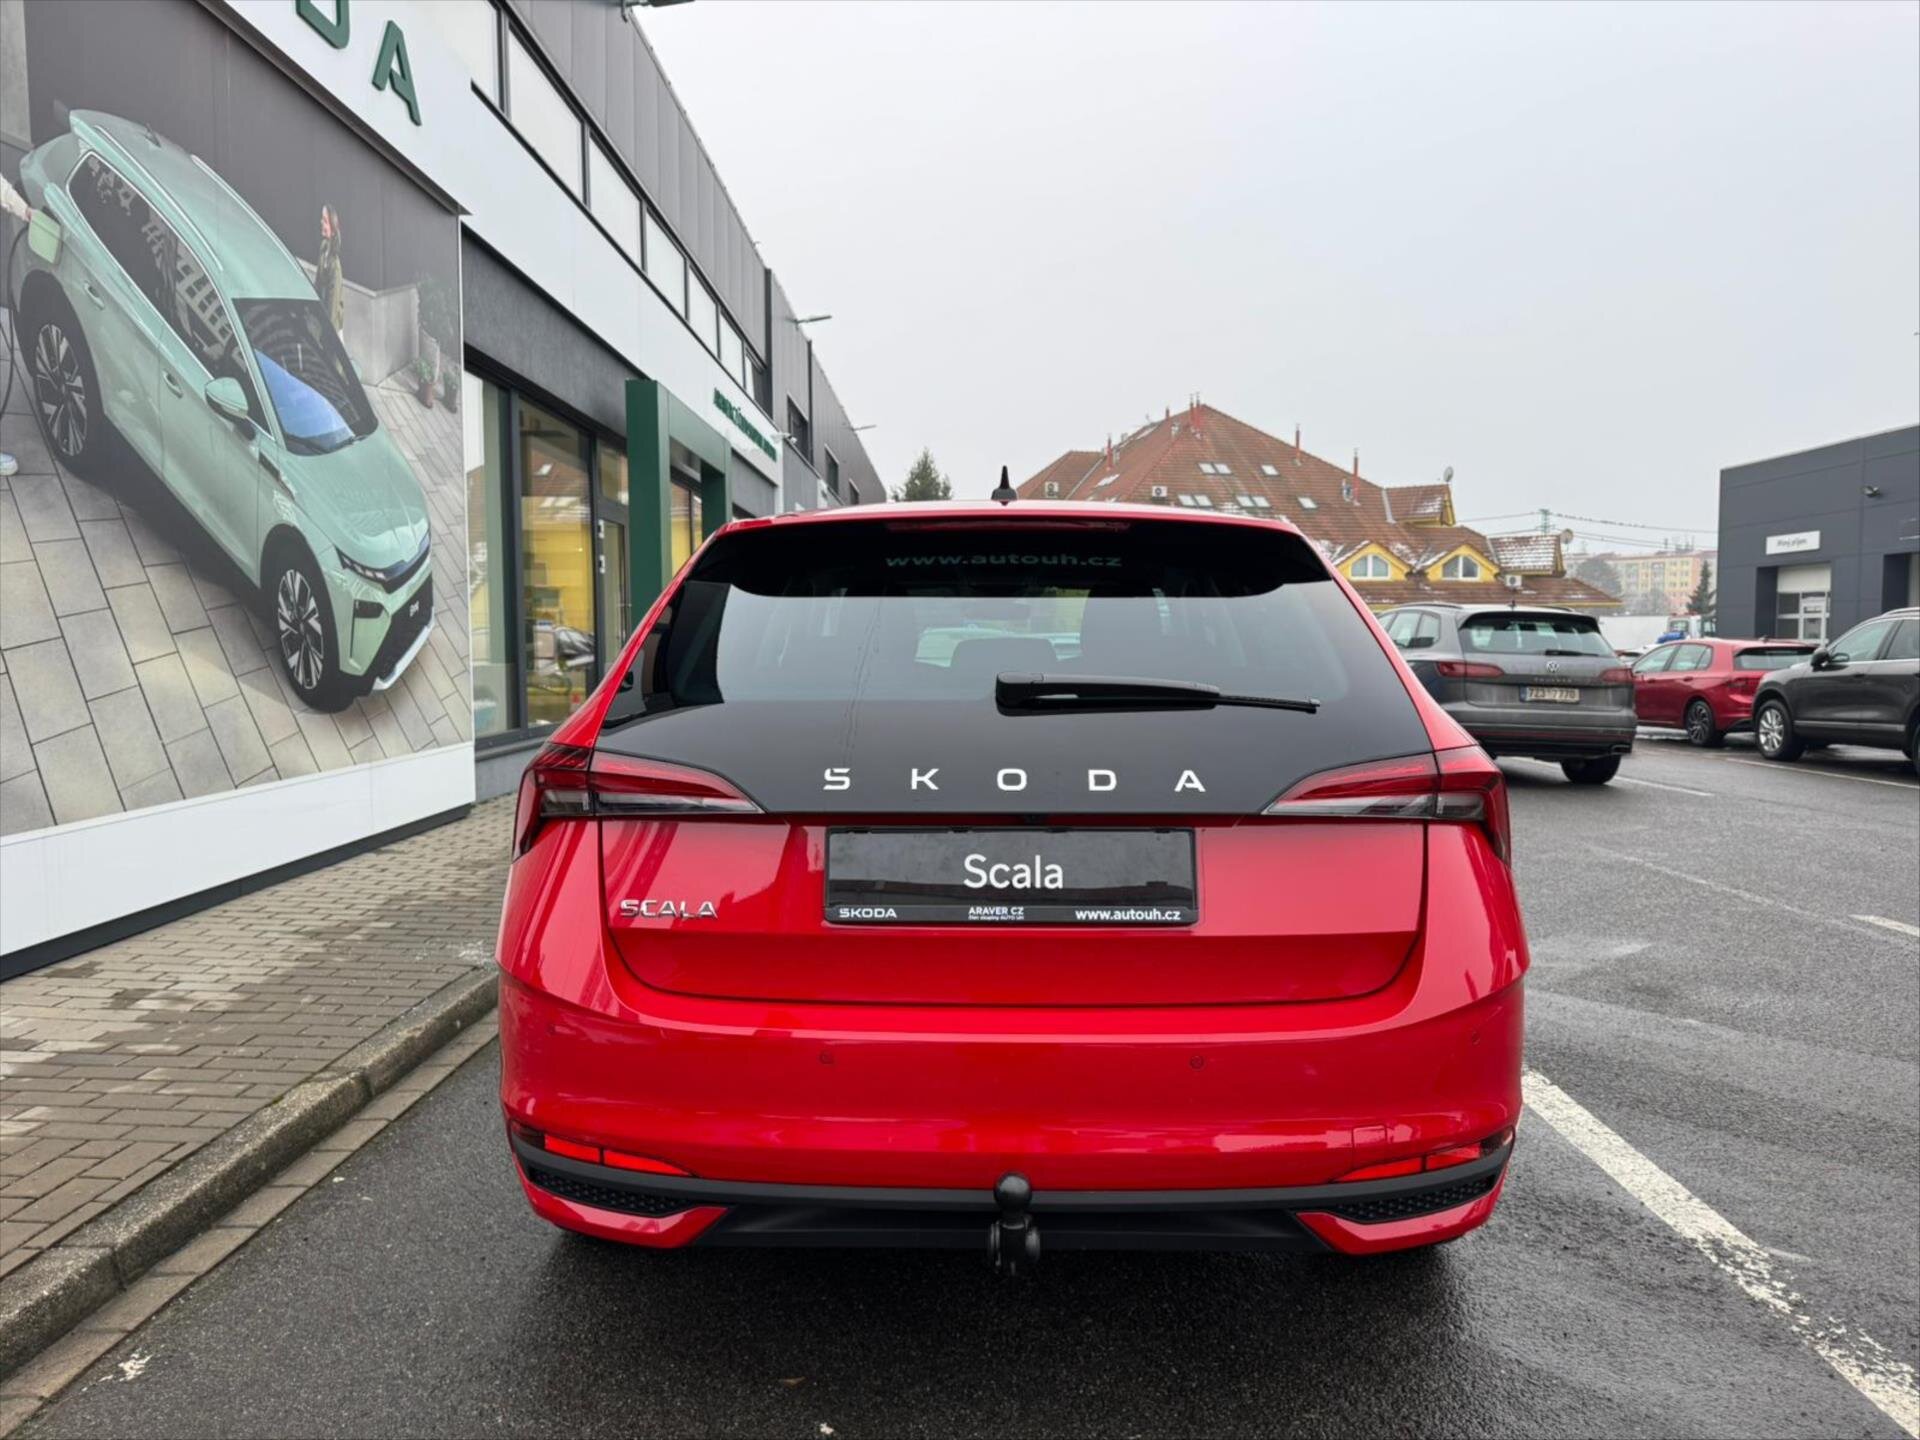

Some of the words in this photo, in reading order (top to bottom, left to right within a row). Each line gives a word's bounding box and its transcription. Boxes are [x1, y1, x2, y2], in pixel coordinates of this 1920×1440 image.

[885, 553, 1122, 567] www.autouh.cz
[963, 853, 1064, 889] Scala
[620, 899, 718, 919] SCALA
[968, 906, 1008, 915] ARAVER
[1010, 906, 1024, 915] CZ
[1075, 908, 1181, 920] www.autouh.cz
